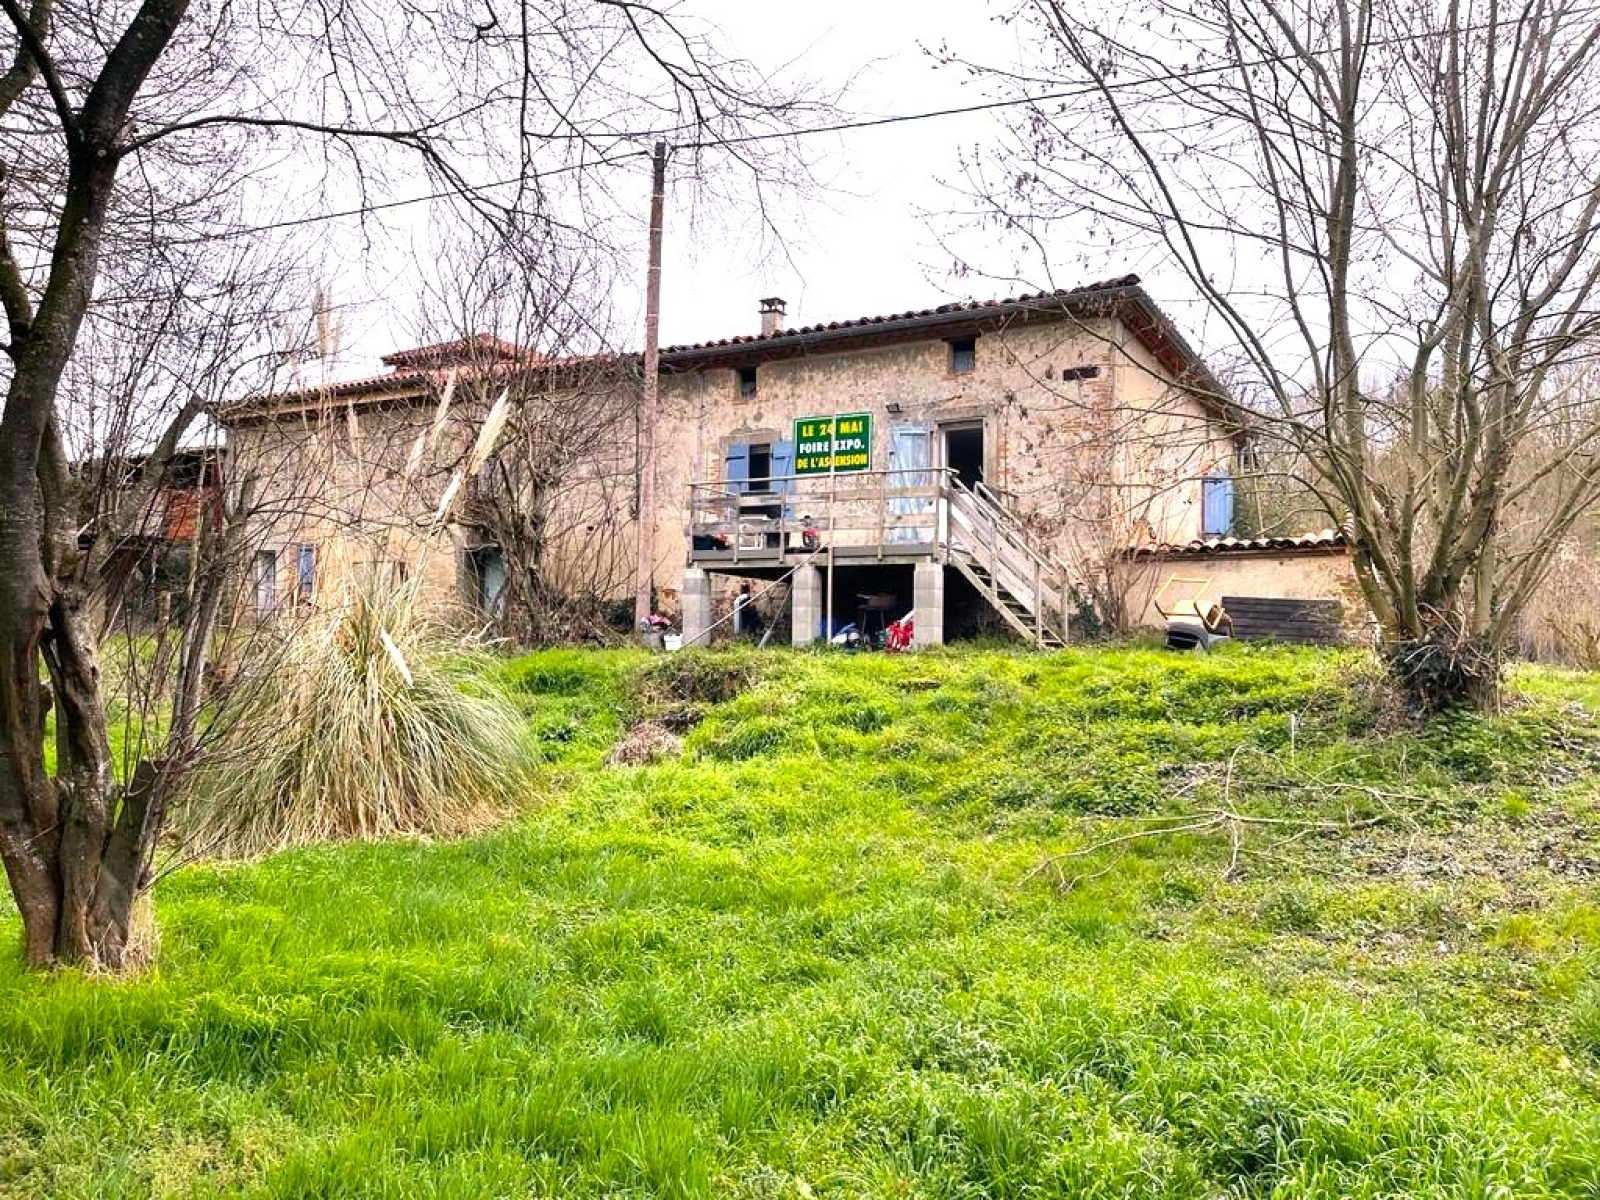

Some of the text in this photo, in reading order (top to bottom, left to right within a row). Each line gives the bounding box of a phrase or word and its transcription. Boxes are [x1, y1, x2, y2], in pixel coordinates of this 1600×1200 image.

[802, 425, 814, 437] LE
[840, 421, 863, 434] MAI
[799, 438, 865, 454] FOIRE EXPO.
[797, 458, 809, 469] DE
